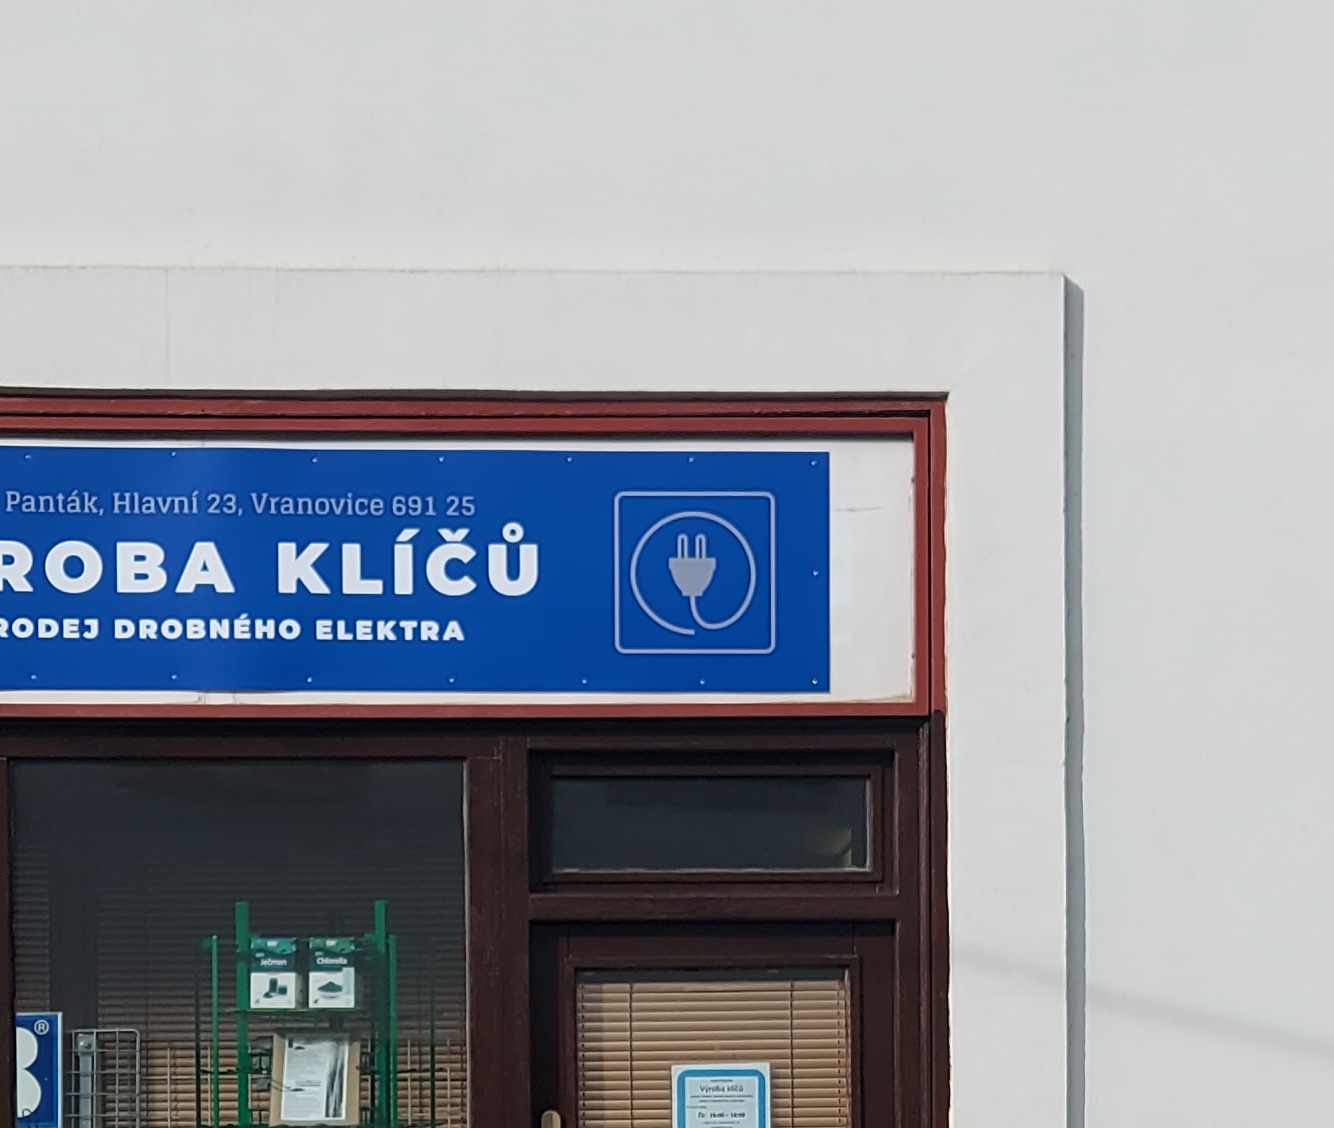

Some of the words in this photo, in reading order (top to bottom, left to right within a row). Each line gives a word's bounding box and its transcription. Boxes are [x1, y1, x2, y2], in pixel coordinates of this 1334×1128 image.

[5, 490, 105, 516] Panták,
[112, 491, 199, 514] Hlavní
[206, 493, 243, 517] 23,
[250, 492, 385, 516] Vranovice
[392, 496, 437, 516] 691
[446, 496, 476, 516] 25
[277, 522, 540, 597] KLÍČŮ
[114, 613, 302, 640] DROBNÉHO
[316, 619, 466, 641] ELEKTRA
